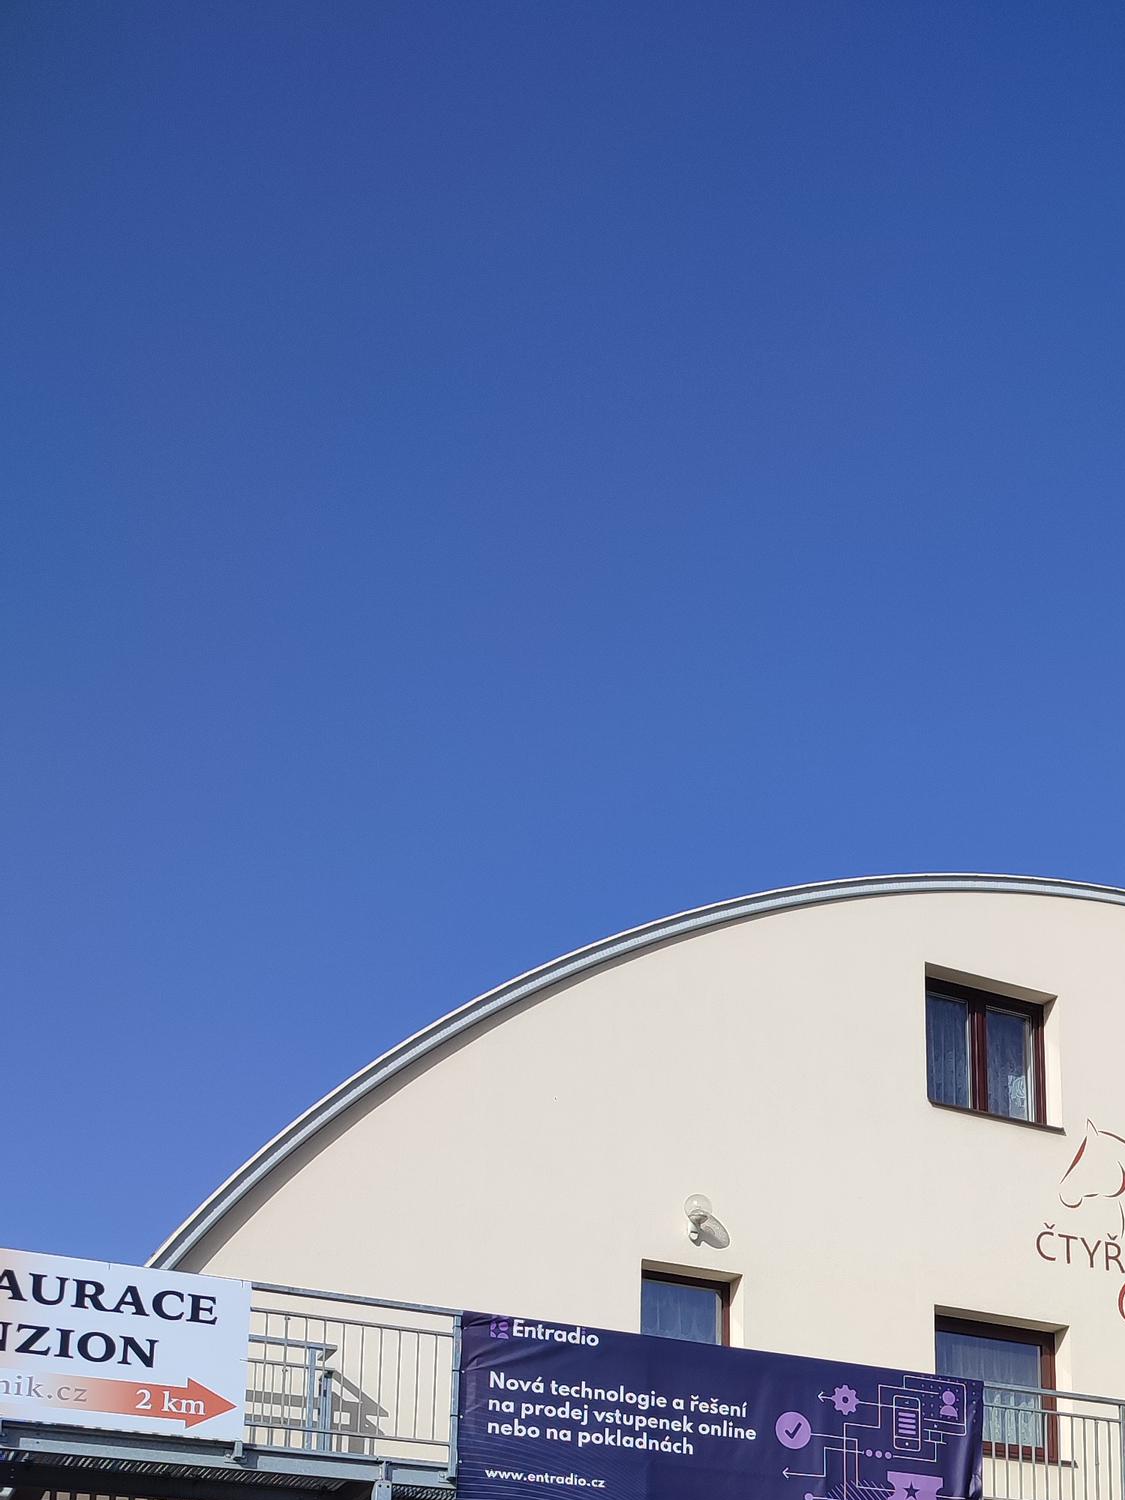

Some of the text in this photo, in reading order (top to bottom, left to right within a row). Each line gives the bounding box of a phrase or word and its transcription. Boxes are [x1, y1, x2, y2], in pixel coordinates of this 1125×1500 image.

[1036, 1222, 1125, 1274] ČTYŘ
[0, 1268, 218, 1325] AURACE
[512, 1319, 600, 1347] Entradio
[135, 1389, 152, 1410] 2
[161, 1391, 206, 1416] km
[489, 1370, 749, 1418] Nová technologie a řešení
[487, 1419, 694, 1455] nebo na pokladnách
[488, 1398, 757, 1441] na prodej vstupenek online
[484, 1467, 606, 1489] www.entradio.cz
